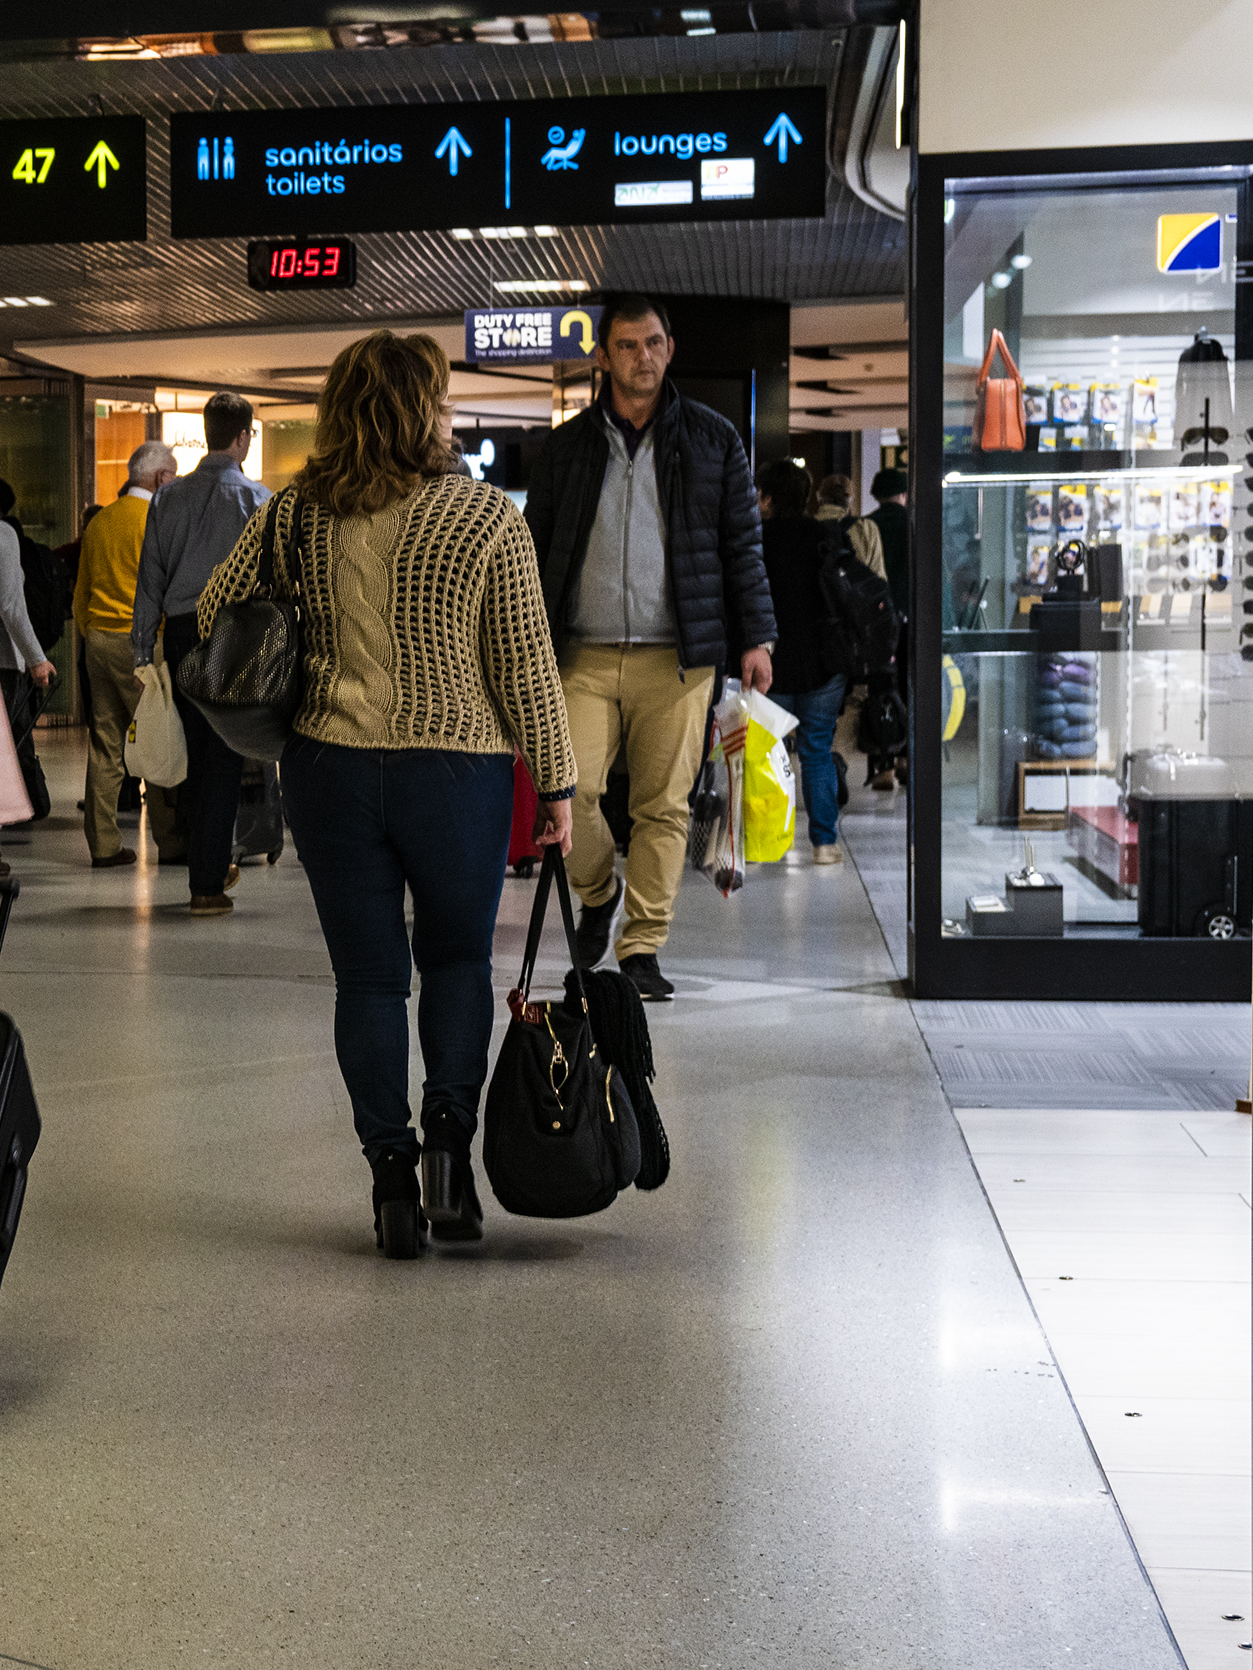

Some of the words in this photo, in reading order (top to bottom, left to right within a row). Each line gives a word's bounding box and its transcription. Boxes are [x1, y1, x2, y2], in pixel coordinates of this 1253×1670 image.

[265, 138, 403, 167] sanitários
[613, 131, 728, 160] lounges
[12, 148, 56, 184] 47
[265, 171, 346, 196] toilets
[270, 247, 340, 279] 10:53
[474, 314, 513, 328] DUTY
[515, 312, 552, 328] FREE
[474, 326, 552, 349] STORE
